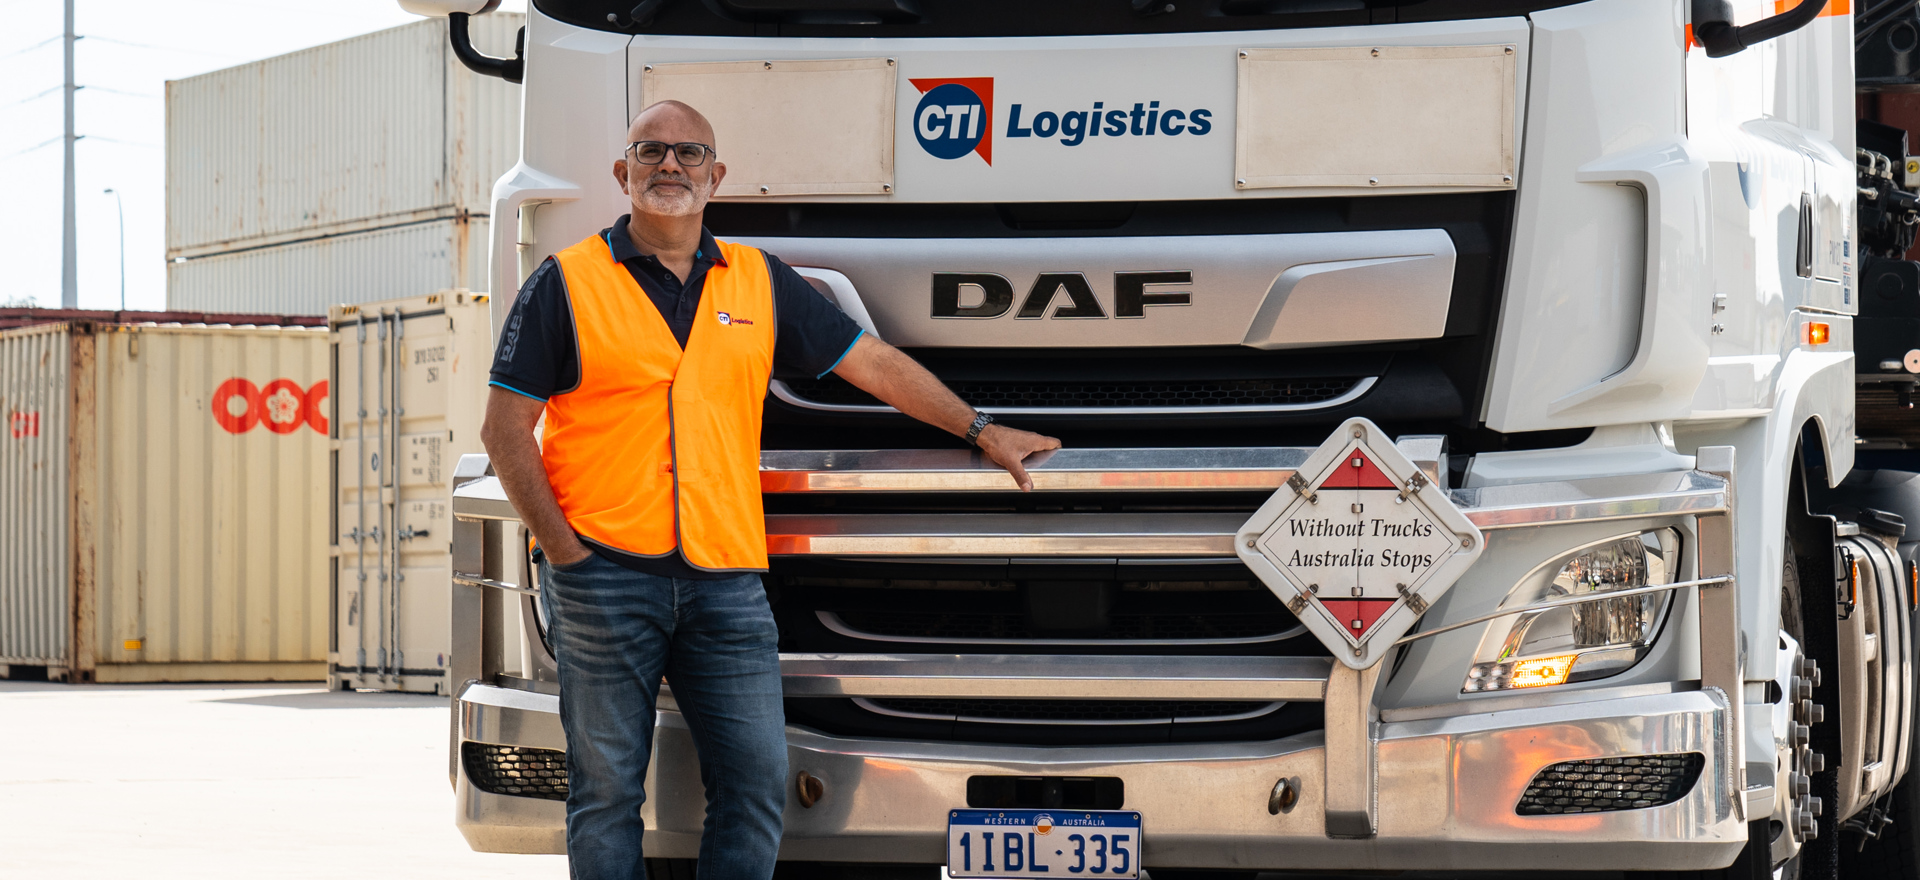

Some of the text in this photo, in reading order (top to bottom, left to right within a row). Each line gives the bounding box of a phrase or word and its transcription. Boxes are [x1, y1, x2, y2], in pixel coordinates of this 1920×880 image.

[918, 100, 1213, 147] CTI Logistics
[930, 269, 1193, 320] DAF
[731, 317, 753, 325] Logistics
[500, 314, 521, 362] DAF
[1288, 518, 1433, 538] Without Trucks
[1287, 548, 1433, 573] Australia Stops
[984, 817, 1106, 827] WESTERN AUSTRALIA
